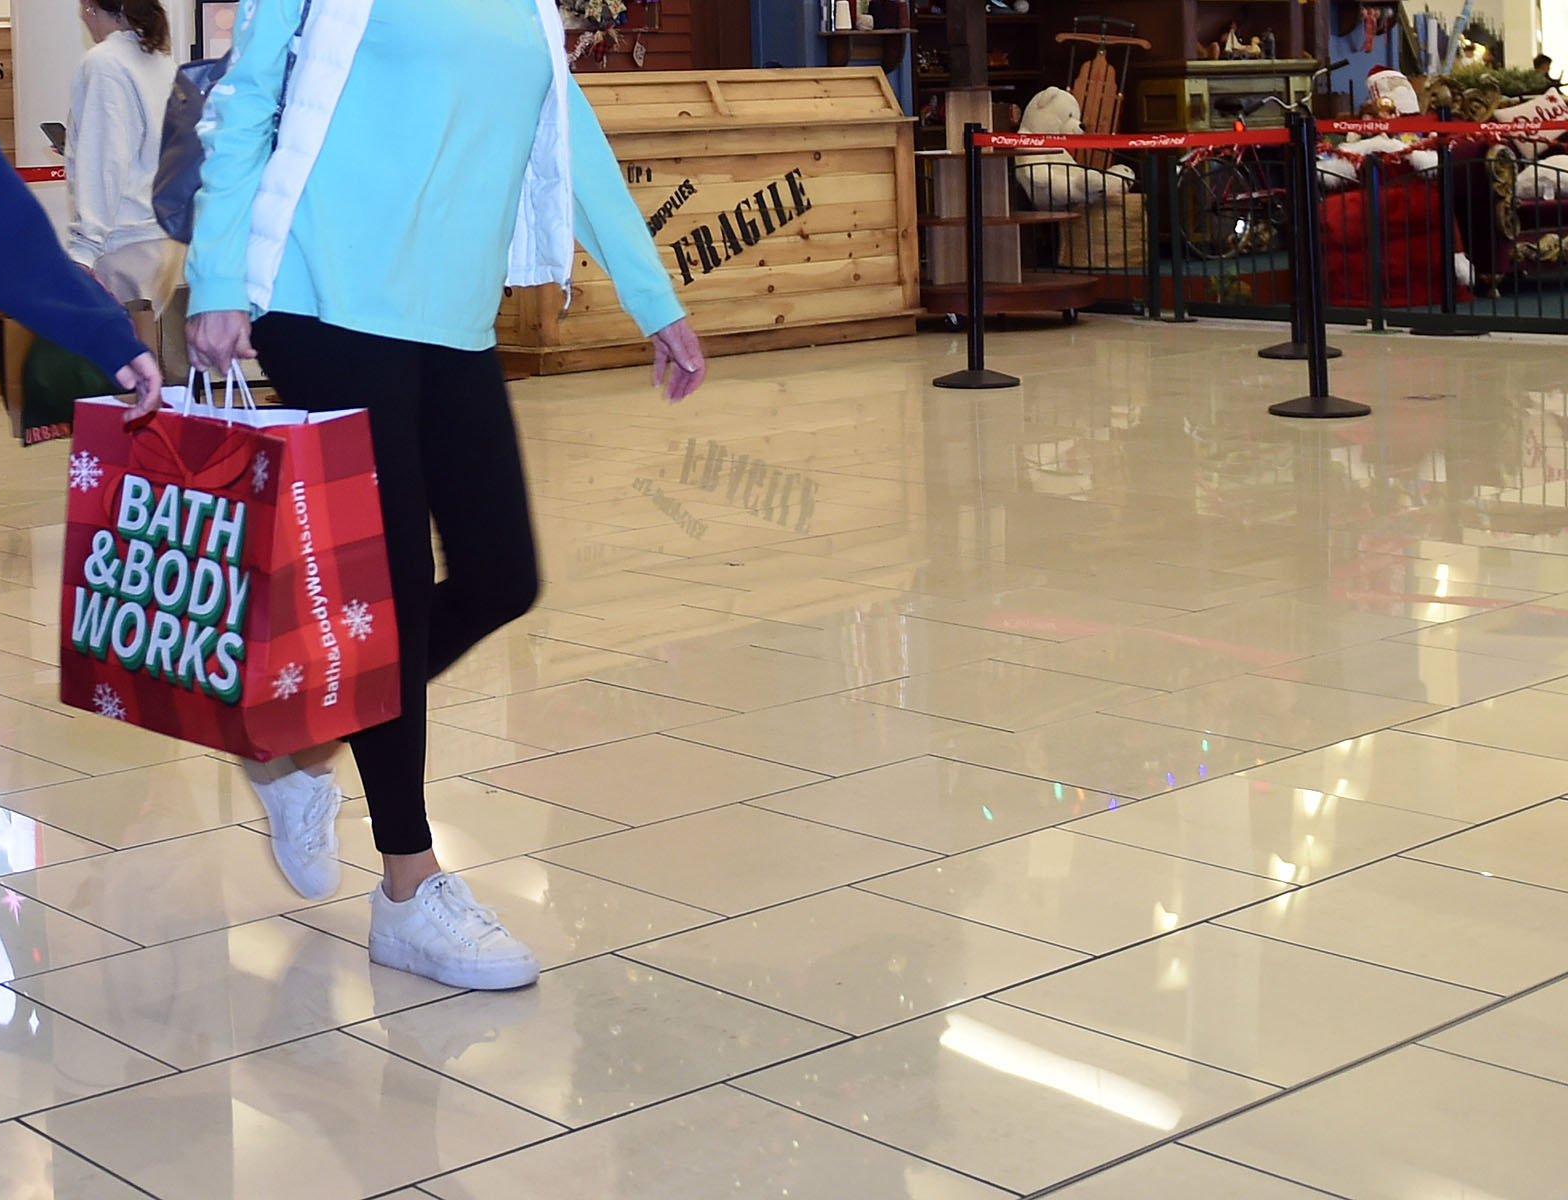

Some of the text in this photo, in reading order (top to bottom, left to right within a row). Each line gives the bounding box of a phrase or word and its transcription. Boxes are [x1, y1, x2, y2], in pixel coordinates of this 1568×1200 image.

[996, 136, 1019, 147] Cherry
[1019, 136, 1031, 146] Hill
[1031, 136, 1045, 146] Mall
[1339, 121, 1389, 132] Cherry Hill Mall
[1486, 121, 1512, 132] Cherry
[627, 165, 643, 184] UP
[646, 178, 695, 238] SUPPLIES
[669, 168, 813, 286] FRAGILE
[25, 422, 71, 444] URBA
[116, 473, 247, 566] BATH
[84, 529, 250, 632] &BODY
[291, 480, 341, 708] Bath&BodyWorks.com
[71, 585, 249, 701] WORKS
